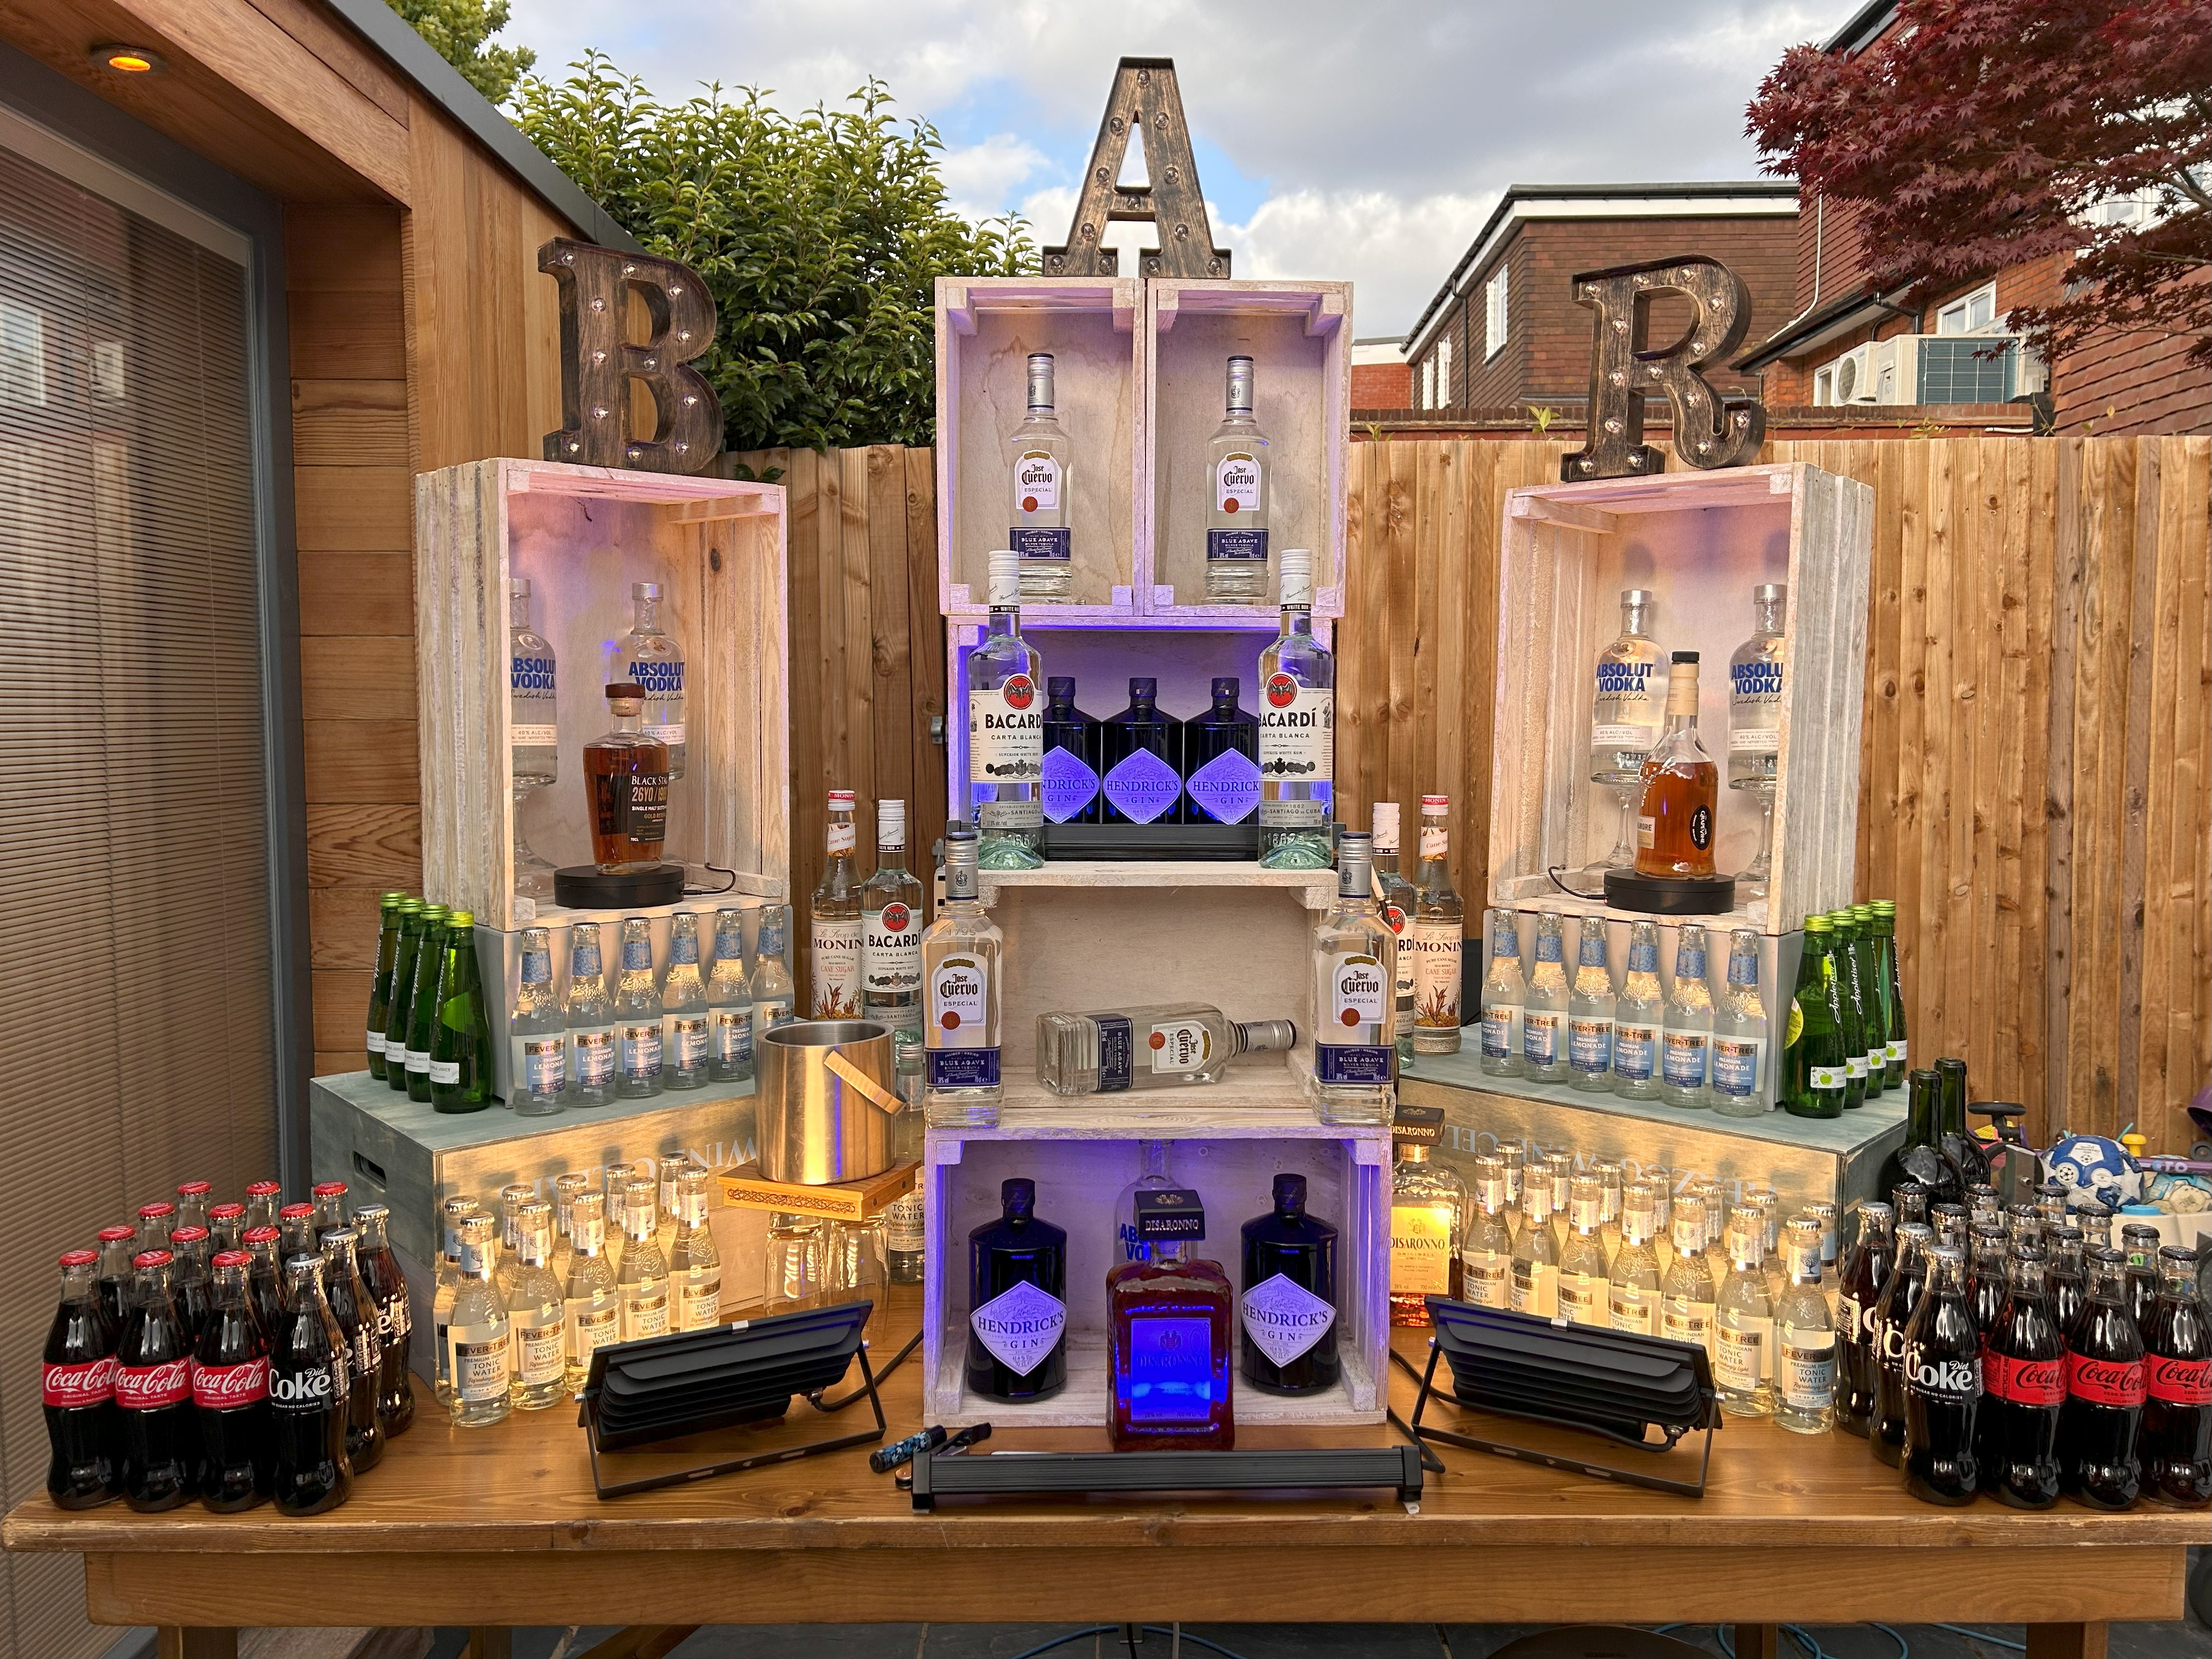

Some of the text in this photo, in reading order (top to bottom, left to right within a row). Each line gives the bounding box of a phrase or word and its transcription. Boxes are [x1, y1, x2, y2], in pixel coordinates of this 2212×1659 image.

[538, 56, 1767, 483] B A R
[1032, 464, 1044, 472] Jose
[1234, 466, 1246, 474] Jose
[1022, 470, 1052, 485] Cuervo
[1224, 471, 1254, 486] Cuervo
[629, 662, 685, 676] ABSOLUT
[1596, 663, 1653, 679] ABSOLUT
[1731, 663, 1784, 680] ABSOLU
[511, 674, 555, 690] VODKA
[636, 677, 682, 691] VODKA
[1599, 678, 1645, 692] VODKA
[1596, 692, 1649, 702] Swedish Vodka
[1732, 696, 1762, 705] Swedish
[631, 776, 656, 785] BLACK
[1042, 778, 1095, 790] NDRICK'S
[1107, 780, 1178, 792] HENDRICK'S
[1193, 781, 1259, 792] HENDRICK
[814, 938, 864, 950] MONIN
[869, 930, 921, 948] BACARDÍ
[1415, 941, 1462, 952] MONIN
[952, 974, 968, 984] Jose
[1353, 970, 1369, 981] Jose
[940, 980, 978, 998] Cuervo
[1341, 977, 1379, 995] Cuervo
[1850, 957, 1861, 1014] Appletiser
[1829, 967, 1840, 1023] Appletiser
[1482, 1012, 1509, 1020] ER-TREE
[1568, 1022, 1610, 1032] FEVER-TREE
[1177, 1029, 1192, 1064] Cuervo
[1615, 1046, 1647, 1056] LEMONADE
[1664, 1054, 1701, 1063] LEMONADE
[1713, 1061, 1750, 1071] LEMONADE
[893, 1204, 923, 1212] TONIC
[892, 1212, 924, 1220] WATER
[1145, 1219, 1199, 1232] DISARONNO
[1390, 1237, 1444, 1250] DISARONNO
[1467, 1282, 1487, 1291] TONIC
[696, 1299, 716, 1310] TONIC
[696, 1307, 717, 1317] WATER
[1243, 1302, 1328, 1327] HENDRICK'S
[642, 1313, 665, 1324] TONIC
[978, 1310, 1064, 1334] HENDRICK'S
[641, 1320, 665, 1331] WATER
[593, 1327, 616, 1338] TONIC
[1268, 1331, 1296, 1341] GIN
[592, 1334, 617, 1345] WATER
[1010, 1339, 1038, 1348] GIN
[534, 1342, 558, 1354] TONIC
[1719, 1346, 1742, 1358] TONIC
[534, 1348, 559, 1361] WATER
[1719, 1353, 1743, 1365] WATER
[473, 1358, 500, 1369] TONIC
[1949, 1360, 1970, 1370] Diet
[304, 1367, 326, 1378] Diet
[473, 1365, 501, 1376] WATER
[1906, 1351, 1973, 1391] Coke
[115, 1361, 188, 1395] Coca-Cola
[193, 1359, 266, 1395] Coca-Cola
[269, 1368, 331, 1400] Coke
